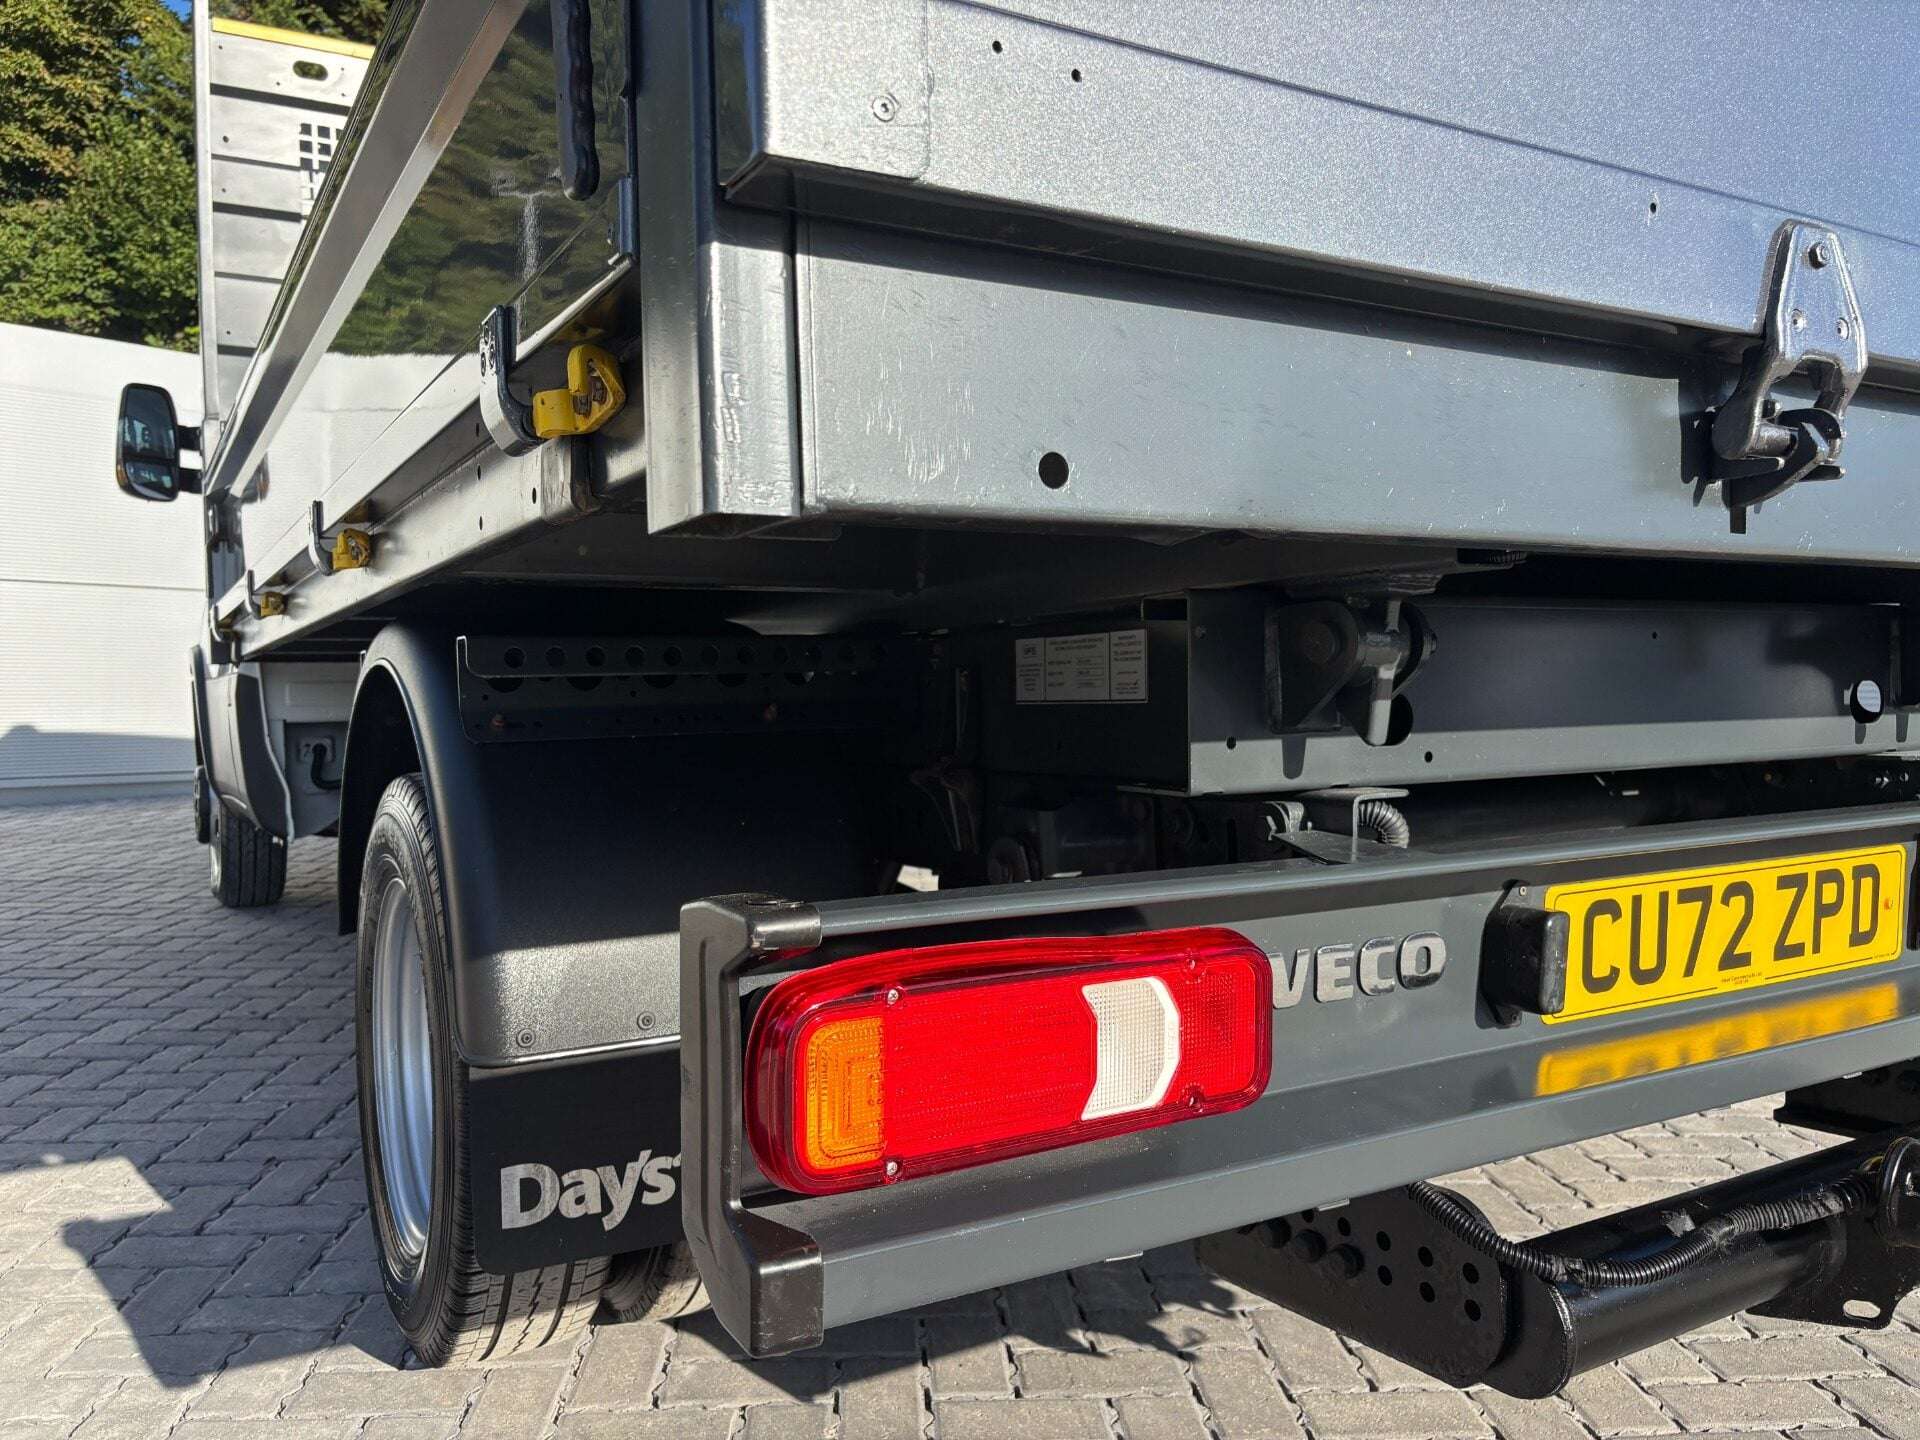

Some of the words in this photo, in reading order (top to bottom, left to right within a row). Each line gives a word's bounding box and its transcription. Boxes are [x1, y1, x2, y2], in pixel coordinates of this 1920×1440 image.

[1268, 930, 1447, 1010] VECO
[1582, 881, 1754, 994] CU72
[1773, 863, 1881, 962] ZPD
[500, 1149, 676, 1232] Day's
